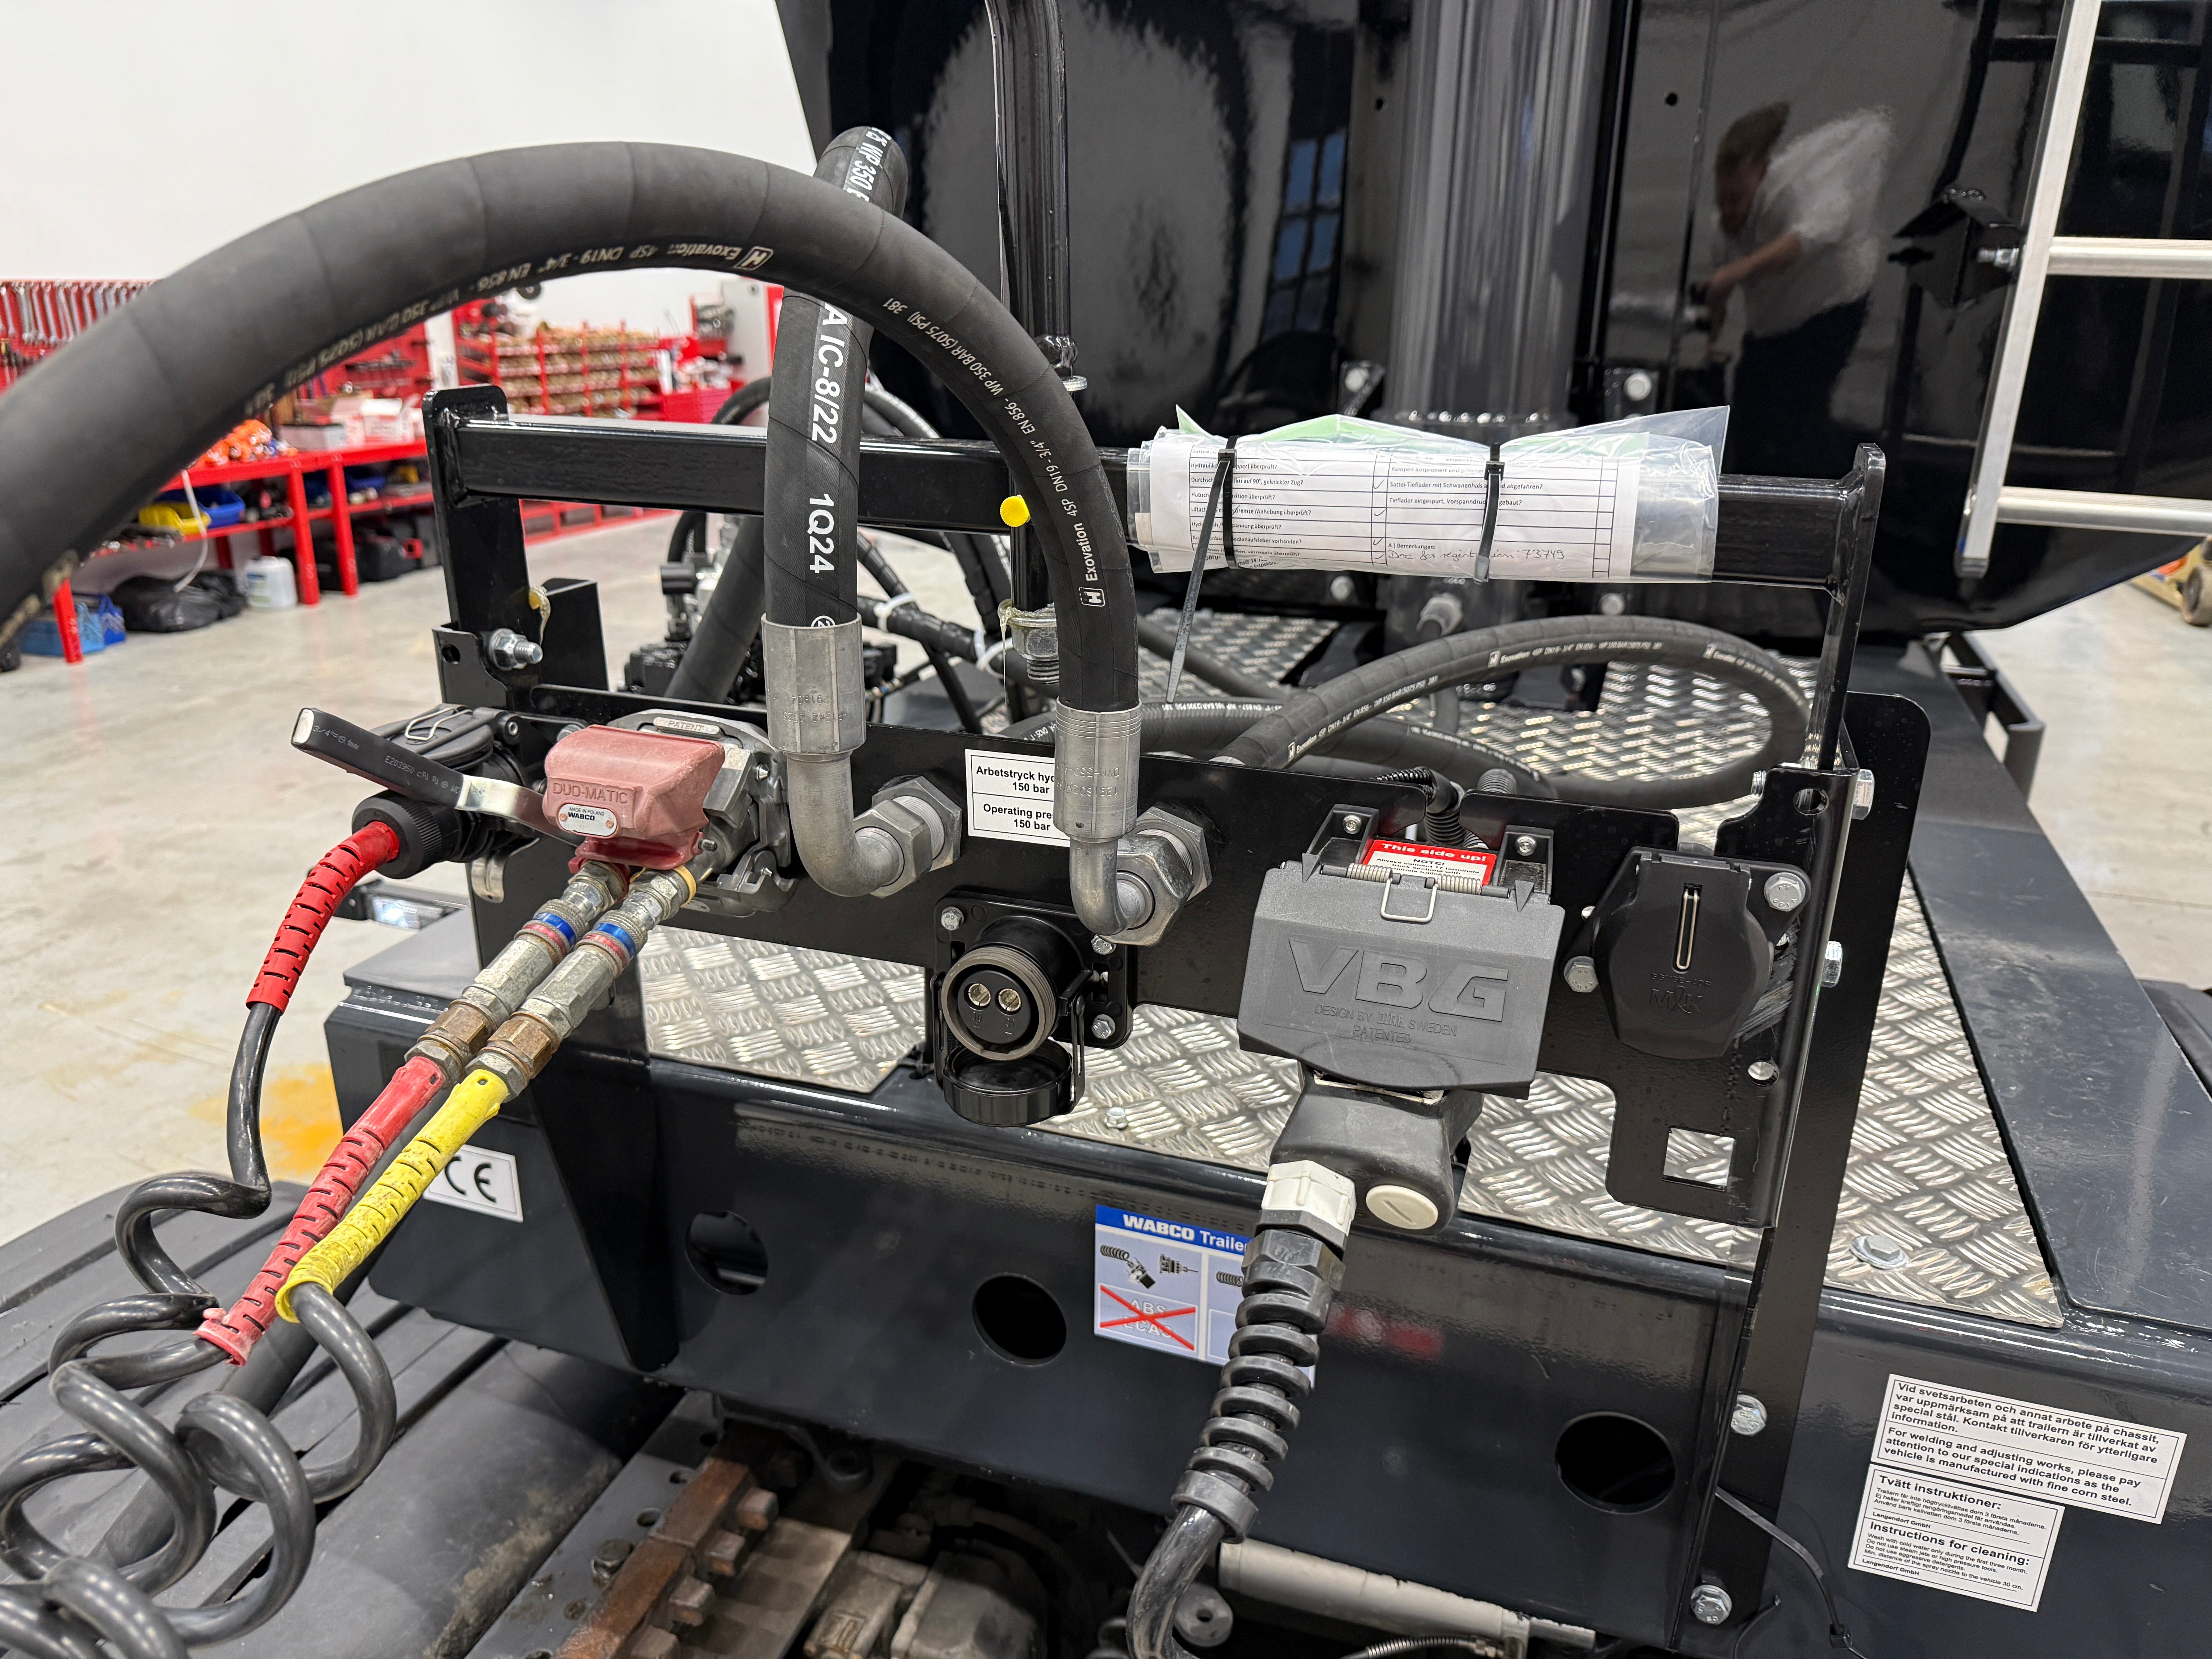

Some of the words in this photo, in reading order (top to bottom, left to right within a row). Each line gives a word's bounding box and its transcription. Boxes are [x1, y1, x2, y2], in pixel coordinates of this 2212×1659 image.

[859, 142, 883, 166] WP
[850, 160, 876, 191] 350
[883, 298, 908, 314] 381
[907, 311, 931, 330] PSI)
[925, 326, 958, 349] (5075
[951, 345, 976, 365] BAR
[969, 362, 992, 380] 350
[811, 336, 846, 444] IC-8/22
[984, 380, 1004, 396] WP
[1018, 419, 1036, 434] EN
[1061, 499, 1078, 517] 4SP
[807, 493, 835, 574] 1Q24
[1073, 522, 1098, 582] Exovation
[976, 766, 1035, 781] Arbetstryck
[553, 782, 628, 804] DUO-MATIC
[1012, 782, 1030, 792] 150
[1033, 783, 1050, 794] bar
[568, 812, 595, 821] WABCO
[983, 803, 1033, 820] Operating
[1036, 808, 1054, 821] pre
[1013, 819, 1031, 829] 150
[1034, 821, 1051, 831] bar
[1381, 843, 1416, 853] This
[1420, 848, 1455, 857] side
[1460, 853, 1487, 862] up!
[1288, 938, 1509, 1023] VBG
[1315, 1004, 1354, 1019] DESIGN
[1357, 1011, 1373, 1022] BY
[1408, 1019, 1458, 1037] SWEDEN
[1353, 1025, 1412, 1043] PATENTED
[444, 1156, 497, 1203] CE
[1123, 1214, 1195, 1241] WABCO
[1891, 1412, 1958, 1432] information.
[1896, 1394, 1914, 1402] var
[1917, 1398, 1989, 1419] uppmärksam
[2010, 1418, 2025, 1426] att
[2028, 1420, 2069, 1435] trailern
[2072, 1429, 2085, 1438] är
[2088, 1433, 2139, 1449] tillverkat
[1899, 1382, 1916, 1393] Vid
[1919, 1389, 1992, 1409] svetsarbeten
[1995, 1405, 2016, 1414] och
[2020, 1410, 2052, 1421] annat
[2055, 1417, 2092, 1429] arbete
[2113, 1428, 2159, 1444] chassit,
[1894, 1404, 1933, 1417] special
[1936, 1413, 1959, 1423] stål.
[1963, 1417, 2008, 1432] Kontakt
[2011, 1427, 2075, 1446] tillverkaren
[2078, 1441, 2095, 1450] för
[2097, 1446, 2157, 1463] ytterligare
[1886, 1438, 1934, 1453] attention
[1938, 1448, 1949, 1456] to
[1952, 1453, 1972, 1461] our
[1974, 1457, 2014, 1470] special
[2017, 1465, 2080, 1484] indications
[2101, 1483, 2119, 1492] the
[1888, 1427, 1908, 1437] For
[1910, 1433, 1953, 1449] welding
[1956, 1443, 1977, 1452] and
[1980, 1448, 2033, 1466] adjusting
[2037, 1460, 2074, 1474] works,
[2078, 1469, 2116, 1482] please
[2119, 1478, 2141, 1488] pay
[1884, 1447, 1923, 1460] vehicle
[1926, 1455, 1935, 1463] is
[1939, 1459, 2017, 1481] manufactured
[2020, 1477, 2043, 1487] with
[2047, 1481, 2068, 1492] fine
[2071, 1488, 2097, 1498] corn
[2100, 1494, 2131, 1506] steel.
[1879, 1475, 1911, 1490] Tvätt
[1914, 1483, 2001, 1510] instruktioner:
[1870, 1521, 1945, 1546] Instructions
[1949, 1539, 1968, 1551] for
[1971, 1546, 2030, 1566] cleaning:
